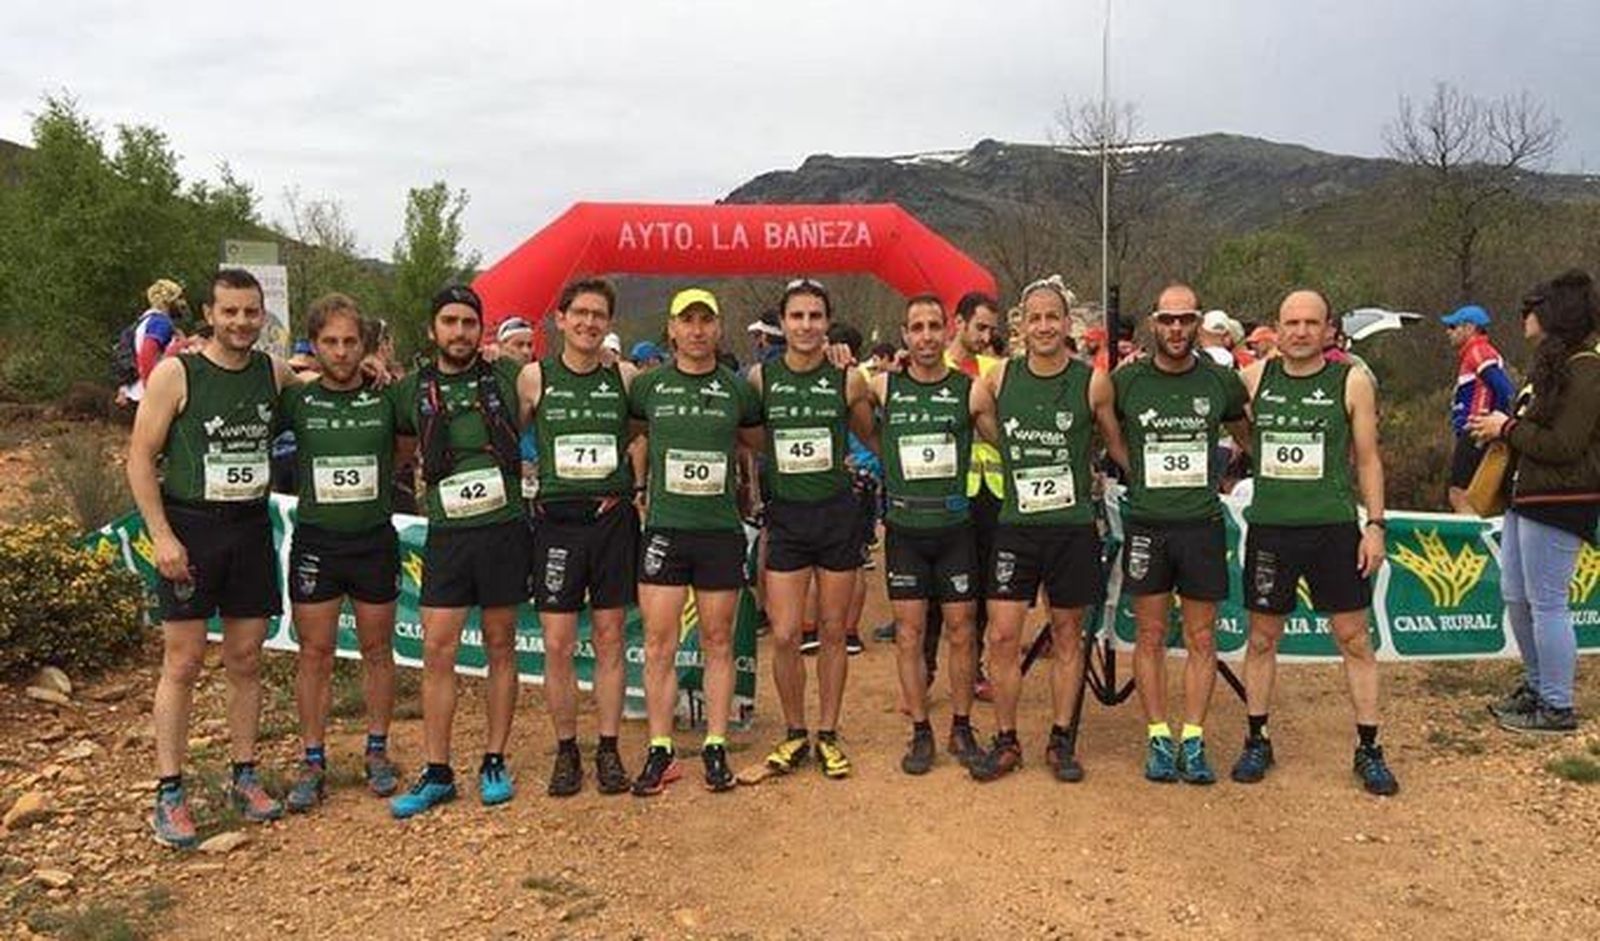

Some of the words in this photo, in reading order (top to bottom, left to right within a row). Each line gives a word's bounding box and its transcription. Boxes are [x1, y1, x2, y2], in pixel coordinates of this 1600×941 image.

[618, 221, 702, 249] AYTO.
[712, 222, 749, 249] LA
[764, 217, 872, 248] BAÑEZA
[573, 448, 598, 463] 71
[789, 441, 815, 457] 45
[922, 447, 935, 462] 9
[1276, 446, 1304, 463] 60
[1163, 454, 1190, 471] 38
[227, 466, 254, 484] 55
[333, 469, 361, 486] 53
[683, 464, 710, 480] 50
[460, 482, 487, 500] 42
[1030, 479, 1056, 496] 72
[1394, 615, 1437, 632] CAJA
[1439, 614, 1498, 631] RURAL
